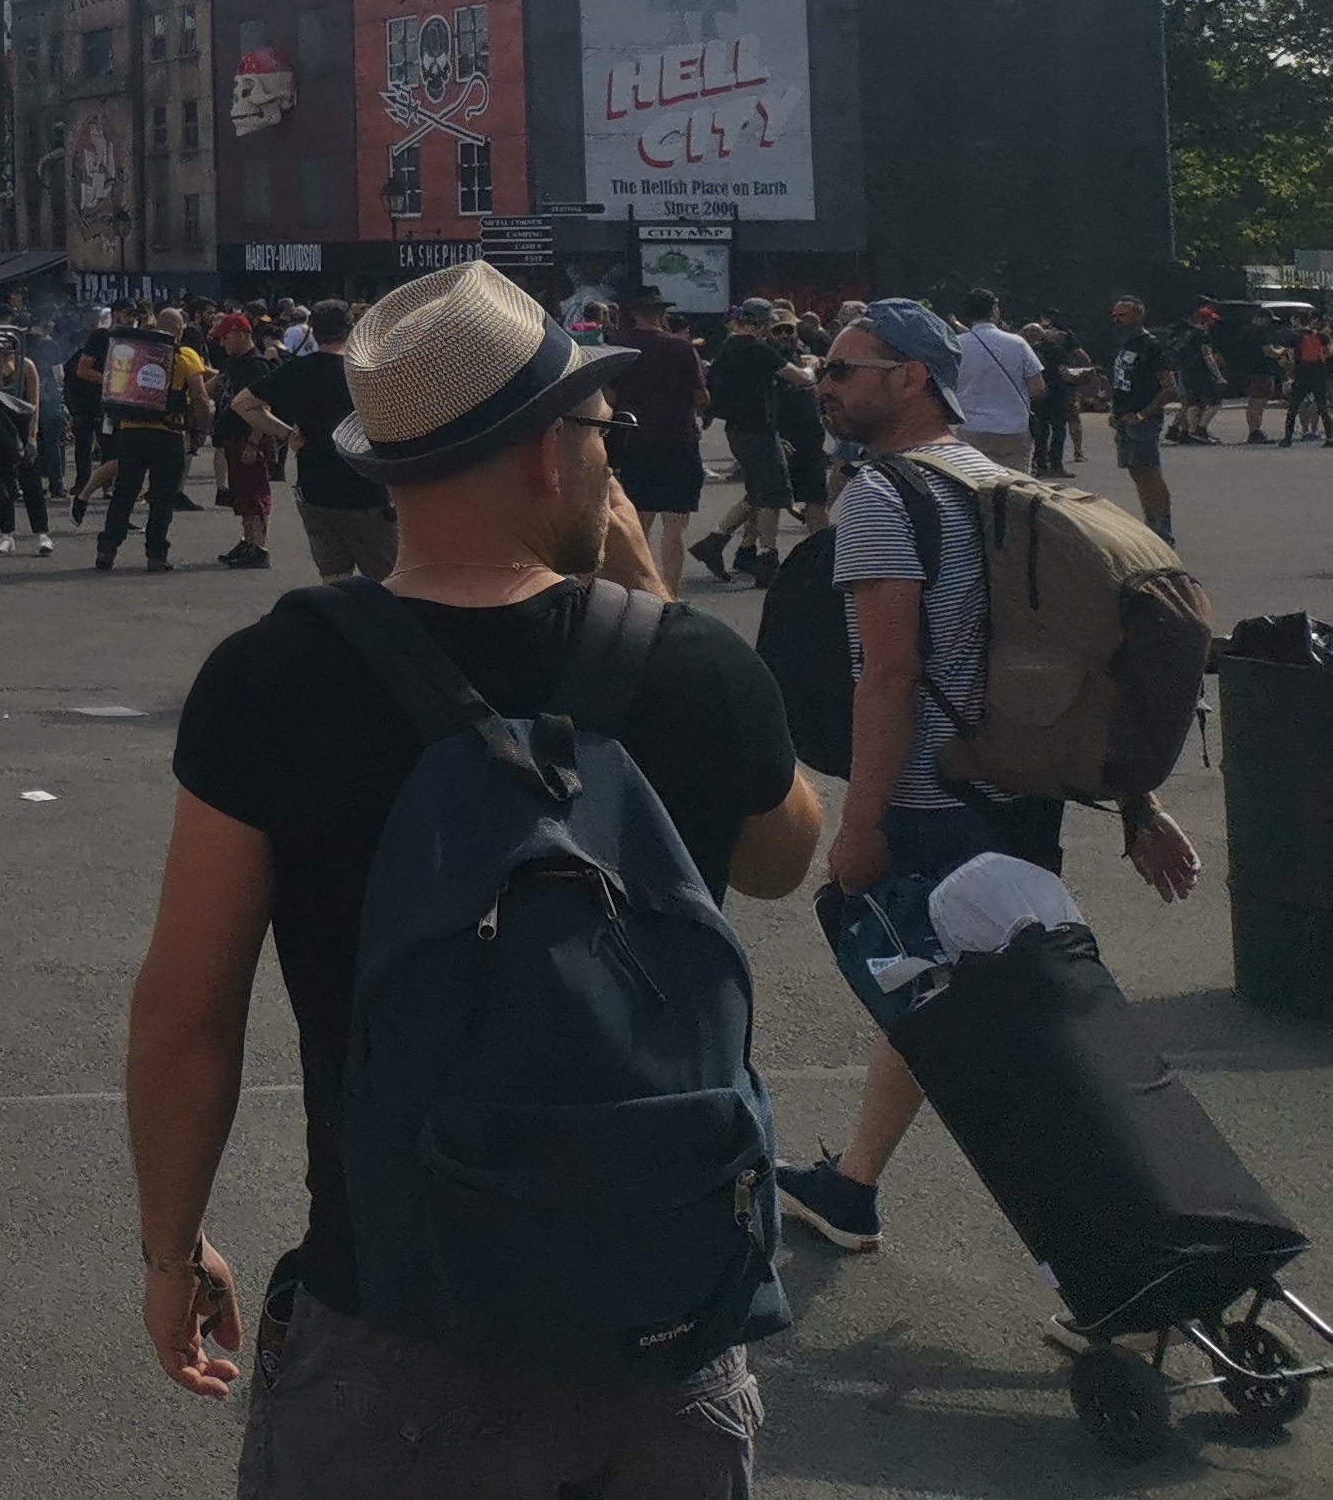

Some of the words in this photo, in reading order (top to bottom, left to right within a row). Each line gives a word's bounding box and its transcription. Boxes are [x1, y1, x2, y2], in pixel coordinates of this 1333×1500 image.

[611, 179, 638, 197] The
[641, 179, 688, 197] Hellish
[691, 180, 730, 197] Place
[733, 183, 750, 198] on
[753, 180, 789, 197] Earth
[664, 200, 700, 217] Since
[647, 228, 683, 238] CITY
[686, 228, 725, 238] MAP
[245, 245, 322, 272] HARLEY-DAVIDSON
